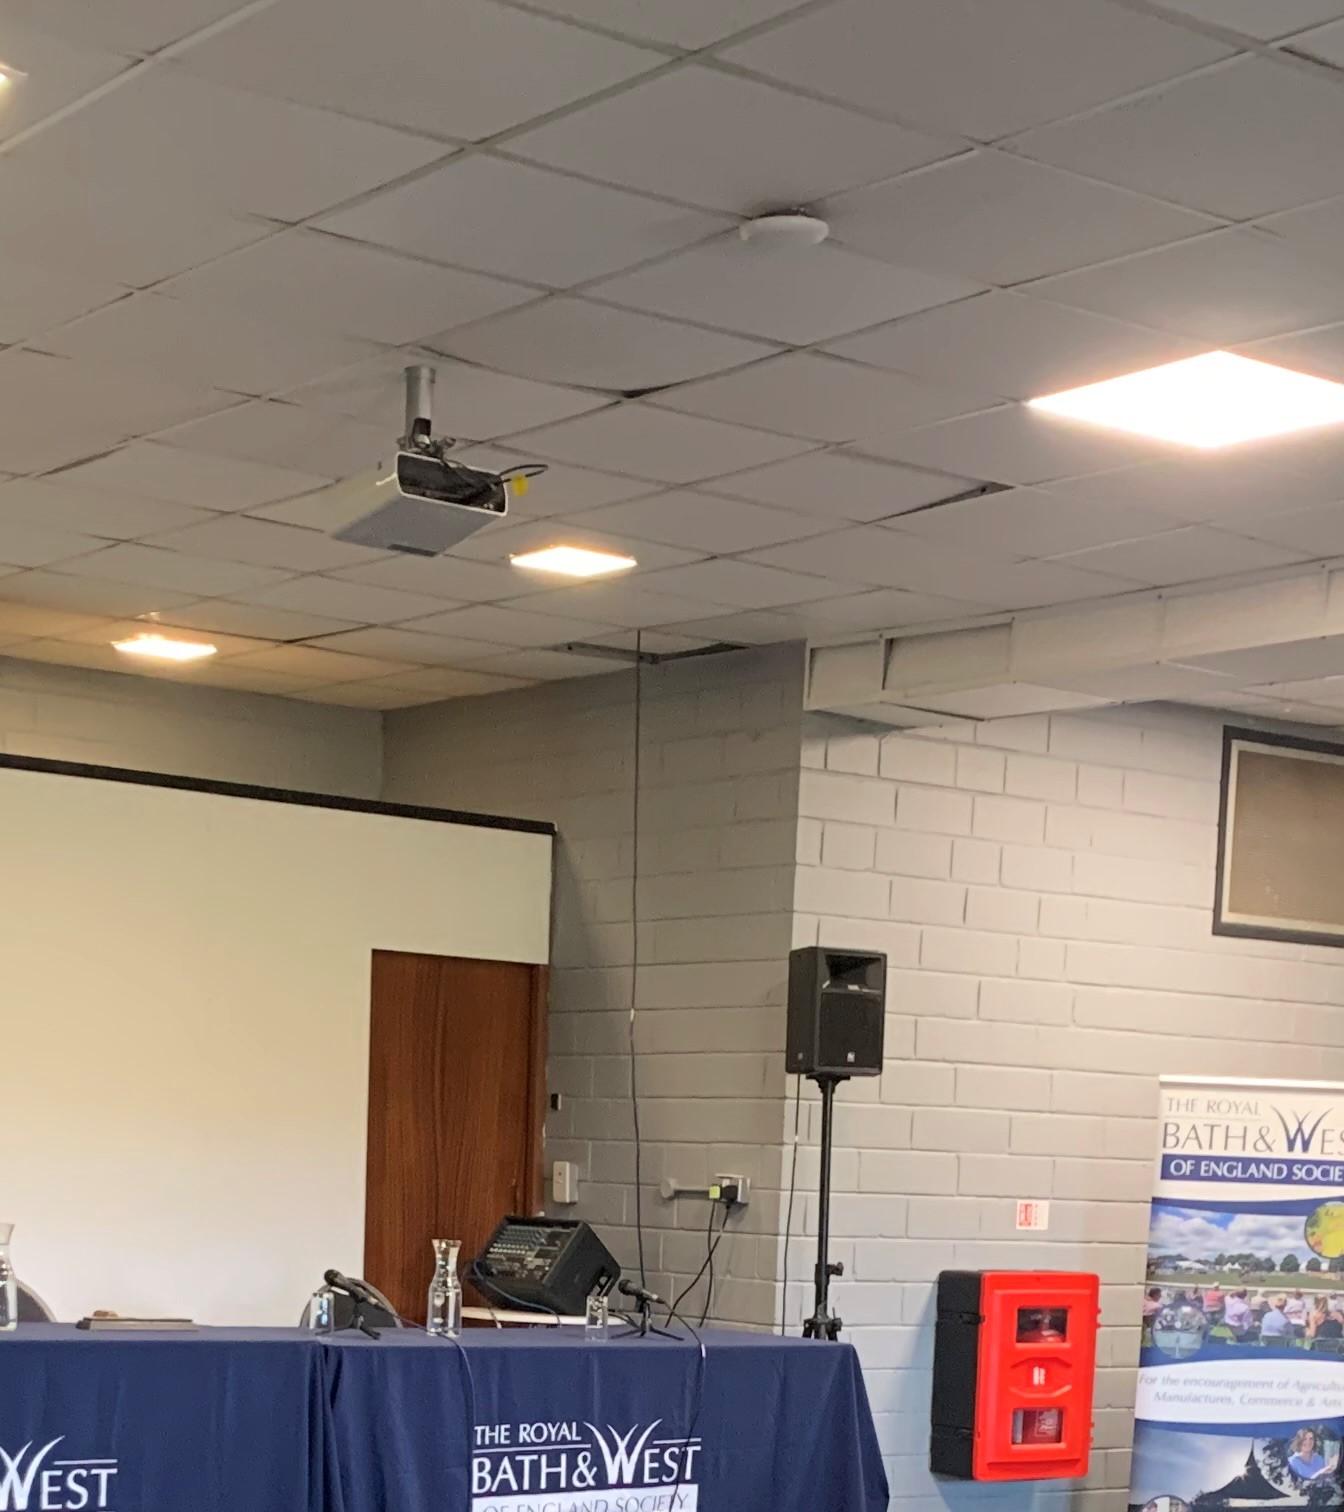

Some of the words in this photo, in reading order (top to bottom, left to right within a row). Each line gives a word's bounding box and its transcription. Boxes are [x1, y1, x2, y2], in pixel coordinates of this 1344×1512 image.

[1167, 1097, 1199, 1113] THE
[1206, 1098, 1262, 1115] ROYAL
[1169, 1159, 1195, 1176] OF
[1200, 1161, 1287, 1180] ENGLAND
[474, 1424, 511, 1445] THE
[518, 1421, 582, 1443] ROYAL
